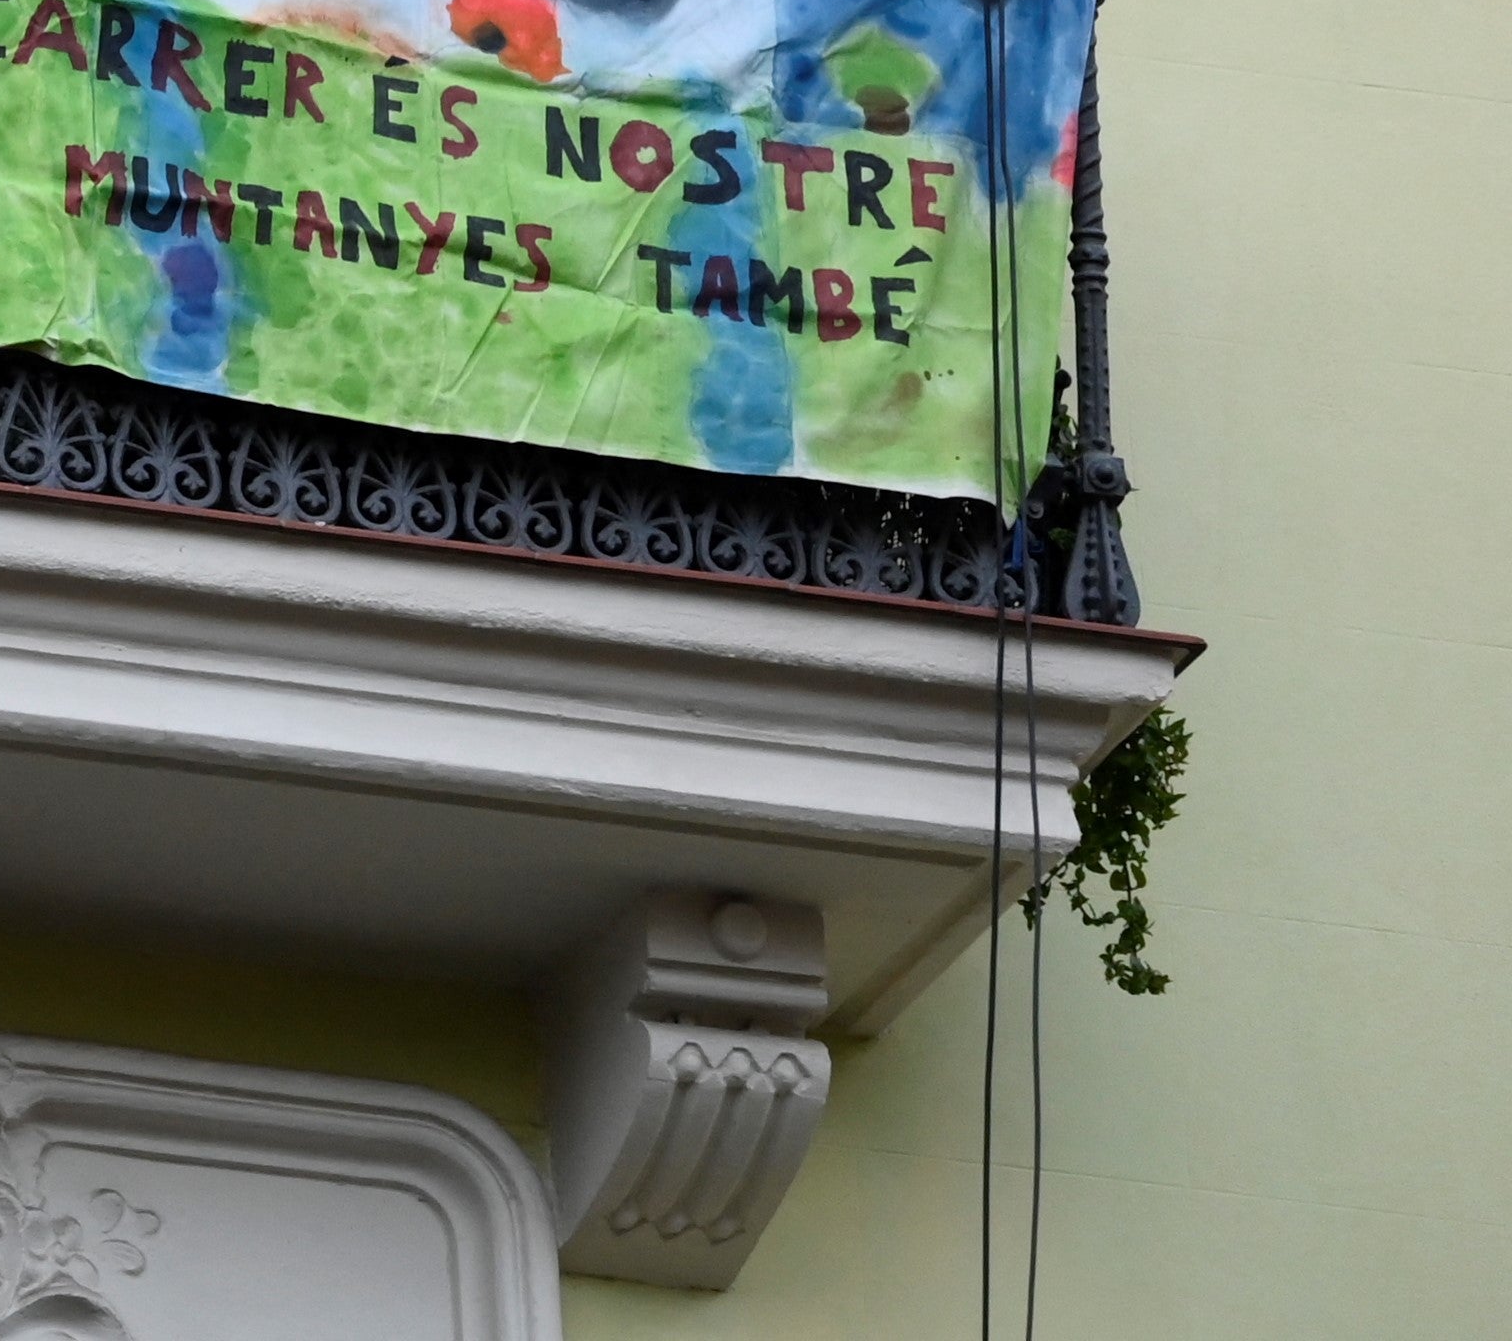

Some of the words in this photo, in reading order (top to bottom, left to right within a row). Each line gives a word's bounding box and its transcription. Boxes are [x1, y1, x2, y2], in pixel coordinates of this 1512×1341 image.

[372, 55, 479, 160] ÉS
[545, 106, 955, 234] NOSTRE
[64, 144, 553, 293] MUNTANYES
[637, 246, 934, 348] TAMBÉ
